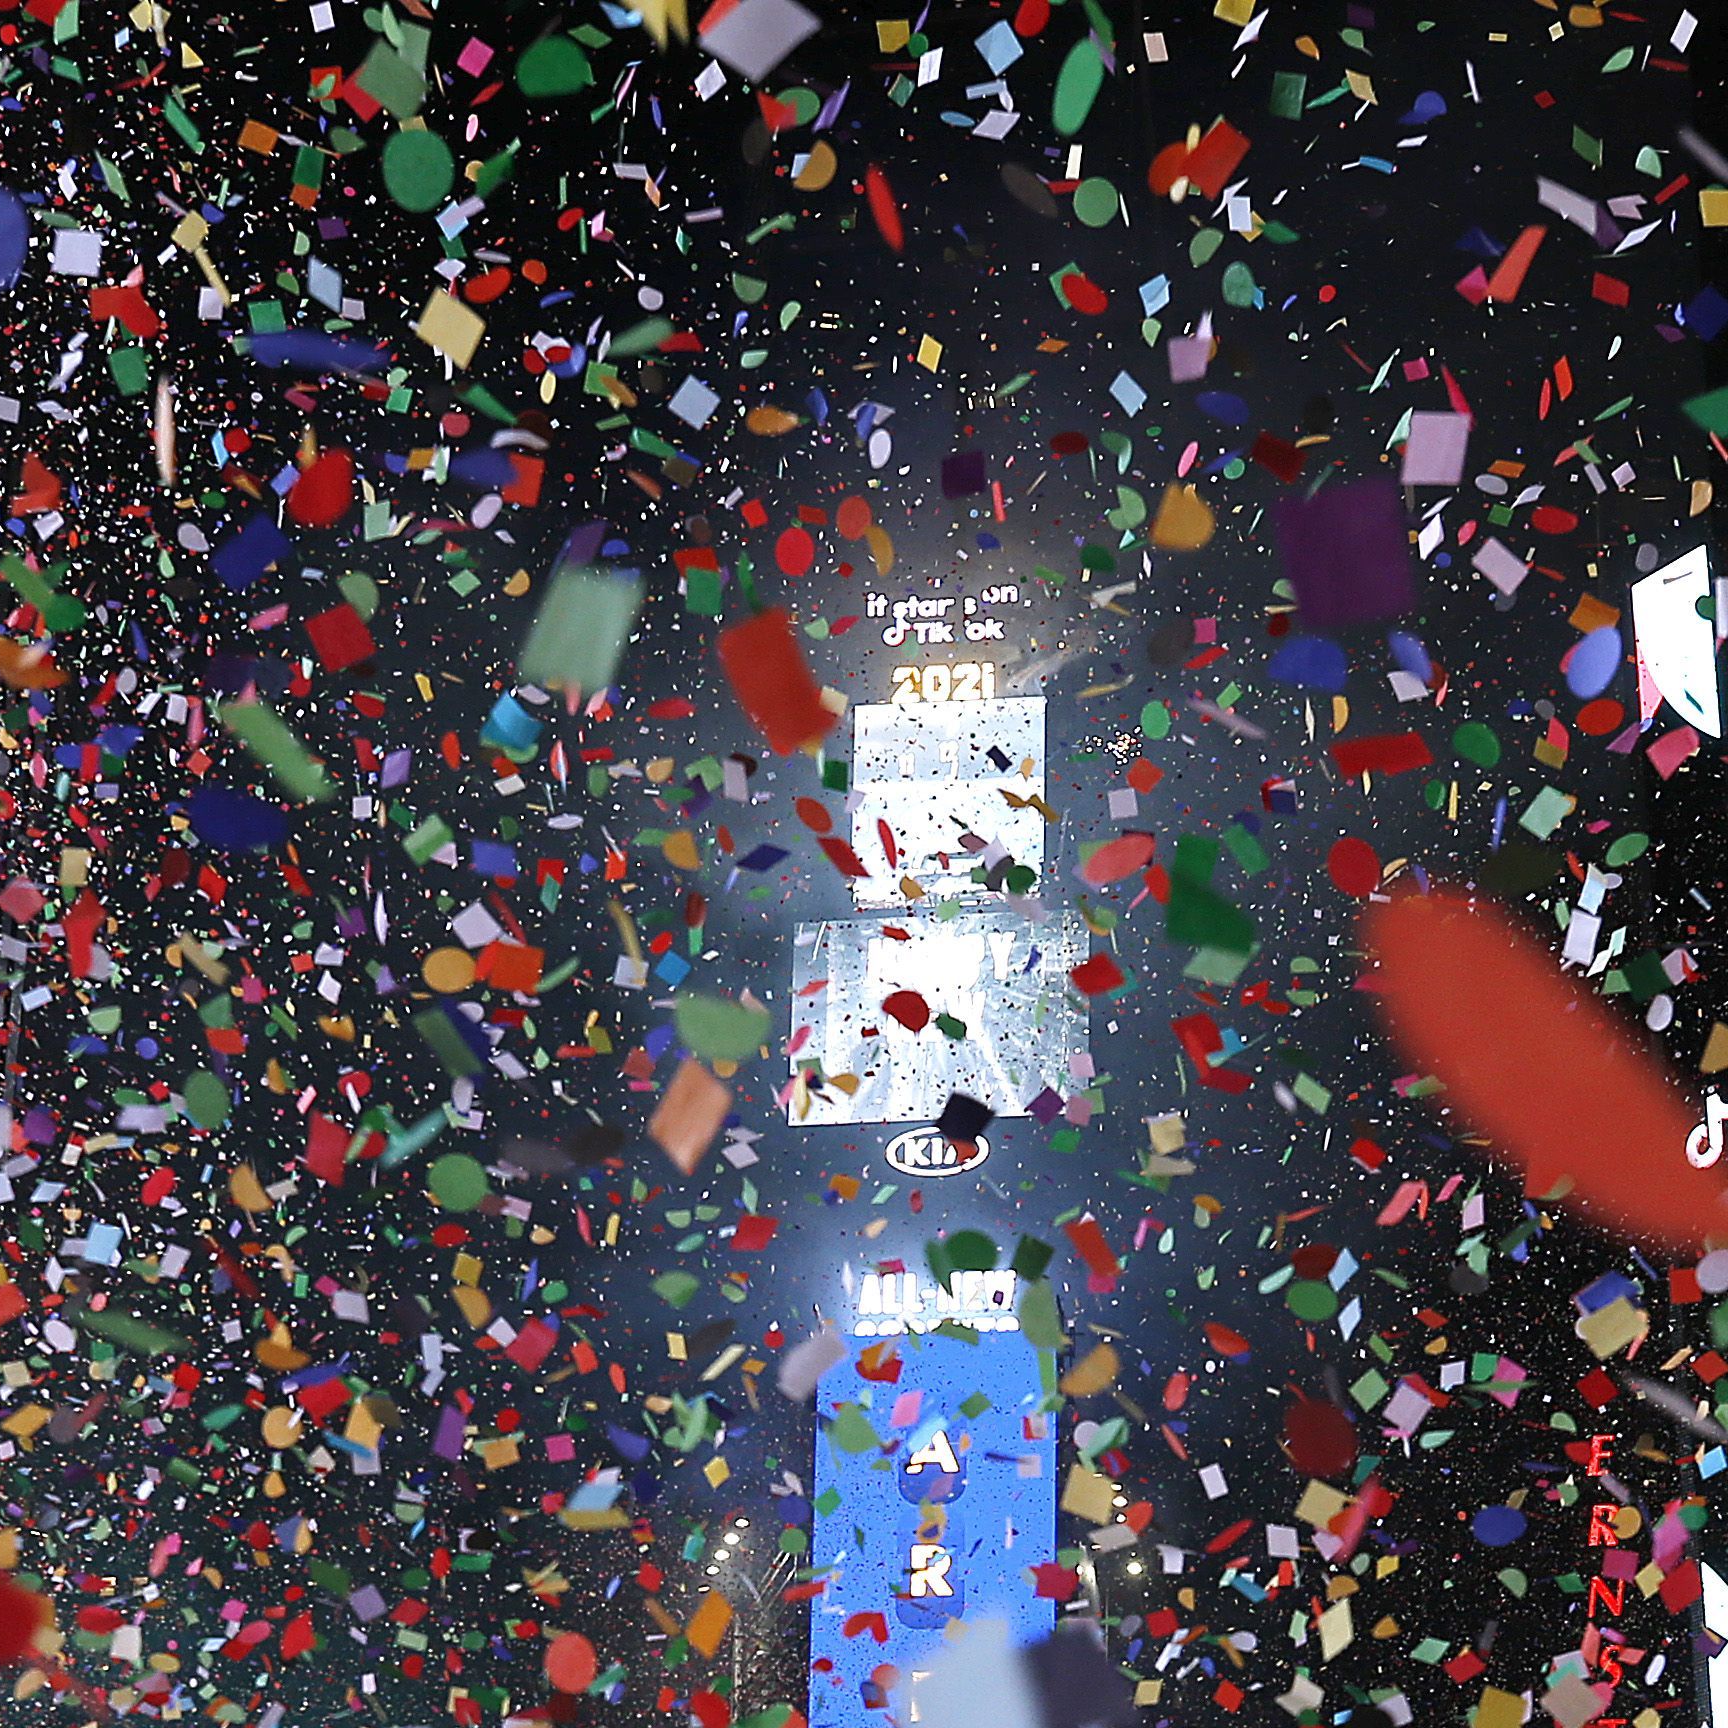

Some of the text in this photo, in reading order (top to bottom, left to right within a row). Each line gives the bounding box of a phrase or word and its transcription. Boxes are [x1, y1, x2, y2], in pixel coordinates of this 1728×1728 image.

[892, 595, 978, 619] stars
[912, 618, 1006, 644] Tikok
[890, 661, 996, 704] 2021
